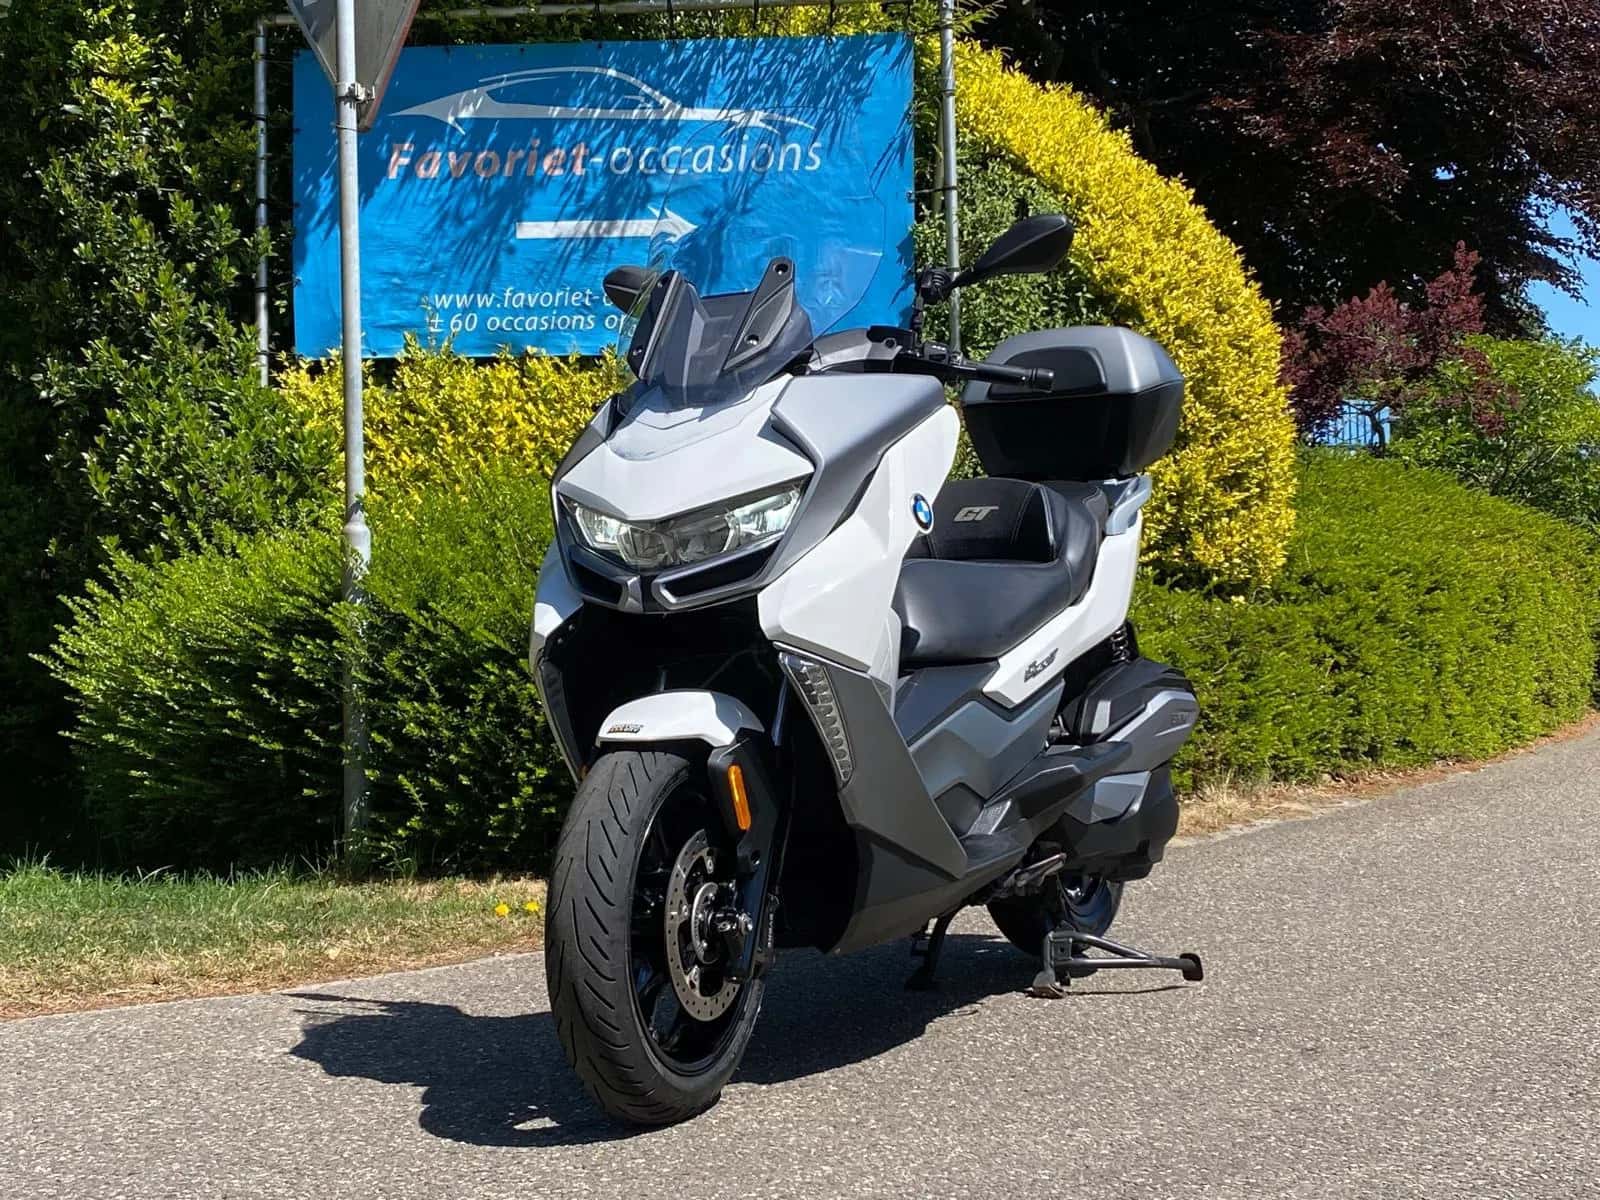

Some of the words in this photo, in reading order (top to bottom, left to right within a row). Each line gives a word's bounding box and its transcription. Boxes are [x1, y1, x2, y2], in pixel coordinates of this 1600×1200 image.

[387, 133, 823, 180] Favoriet-occasions
[486, 309, 596, 332] occasions
[953, 505, 999, 522] GT
